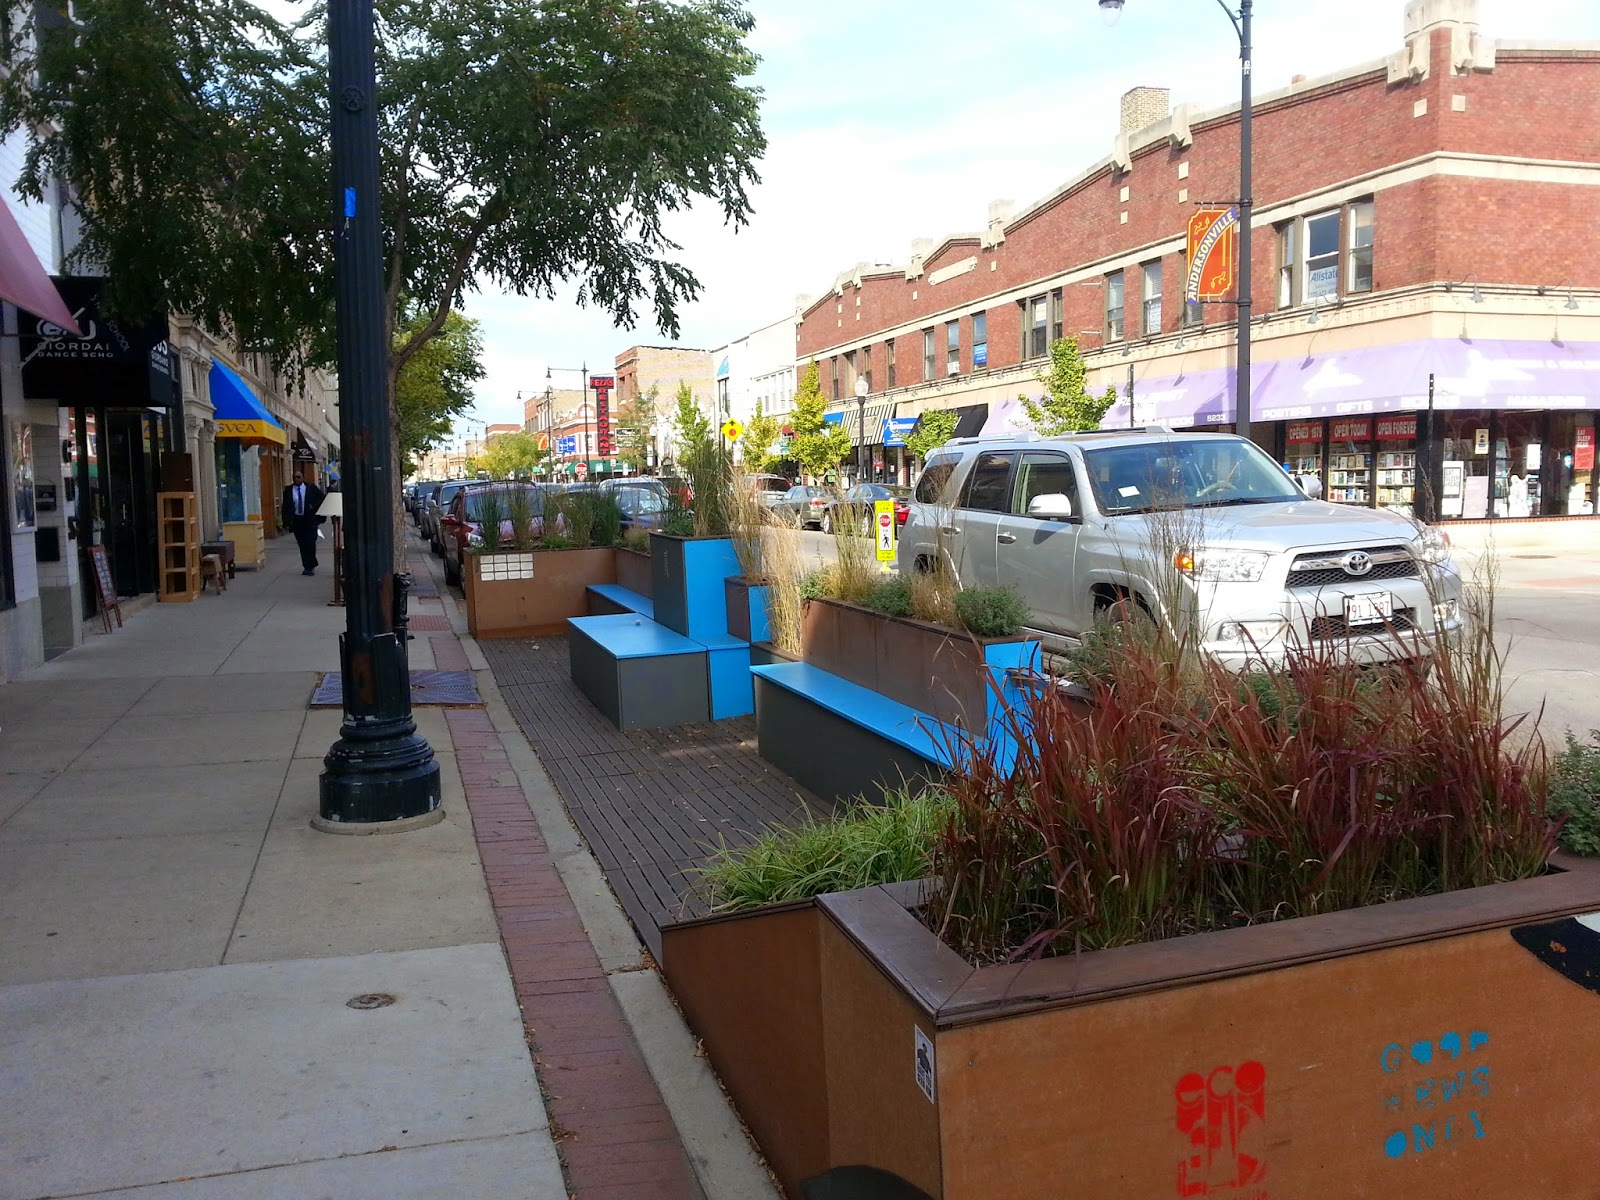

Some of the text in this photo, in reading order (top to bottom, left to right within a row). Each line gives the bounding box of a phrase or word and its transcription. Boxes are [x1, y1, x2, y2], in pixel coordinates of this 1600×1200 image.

[1187, 211, 1235, 301] ANDERSONVILLE
[37, 351, 78, 359] DANCE
[1262, 405, 1312, 420] POSTERS
[1335, 400, 1373, 414] GIFTS
[598, 388, 609, 454] RESTAURANT
[1207, 413, 1227, 422] 5233
[219, 423, 258, 434] SVEA
[1289, 427, 1309, 440] OPENED
[1334, 423, 1368, 438] OPEN TODAY
[1377, 422, 1393, 436] OPEN
